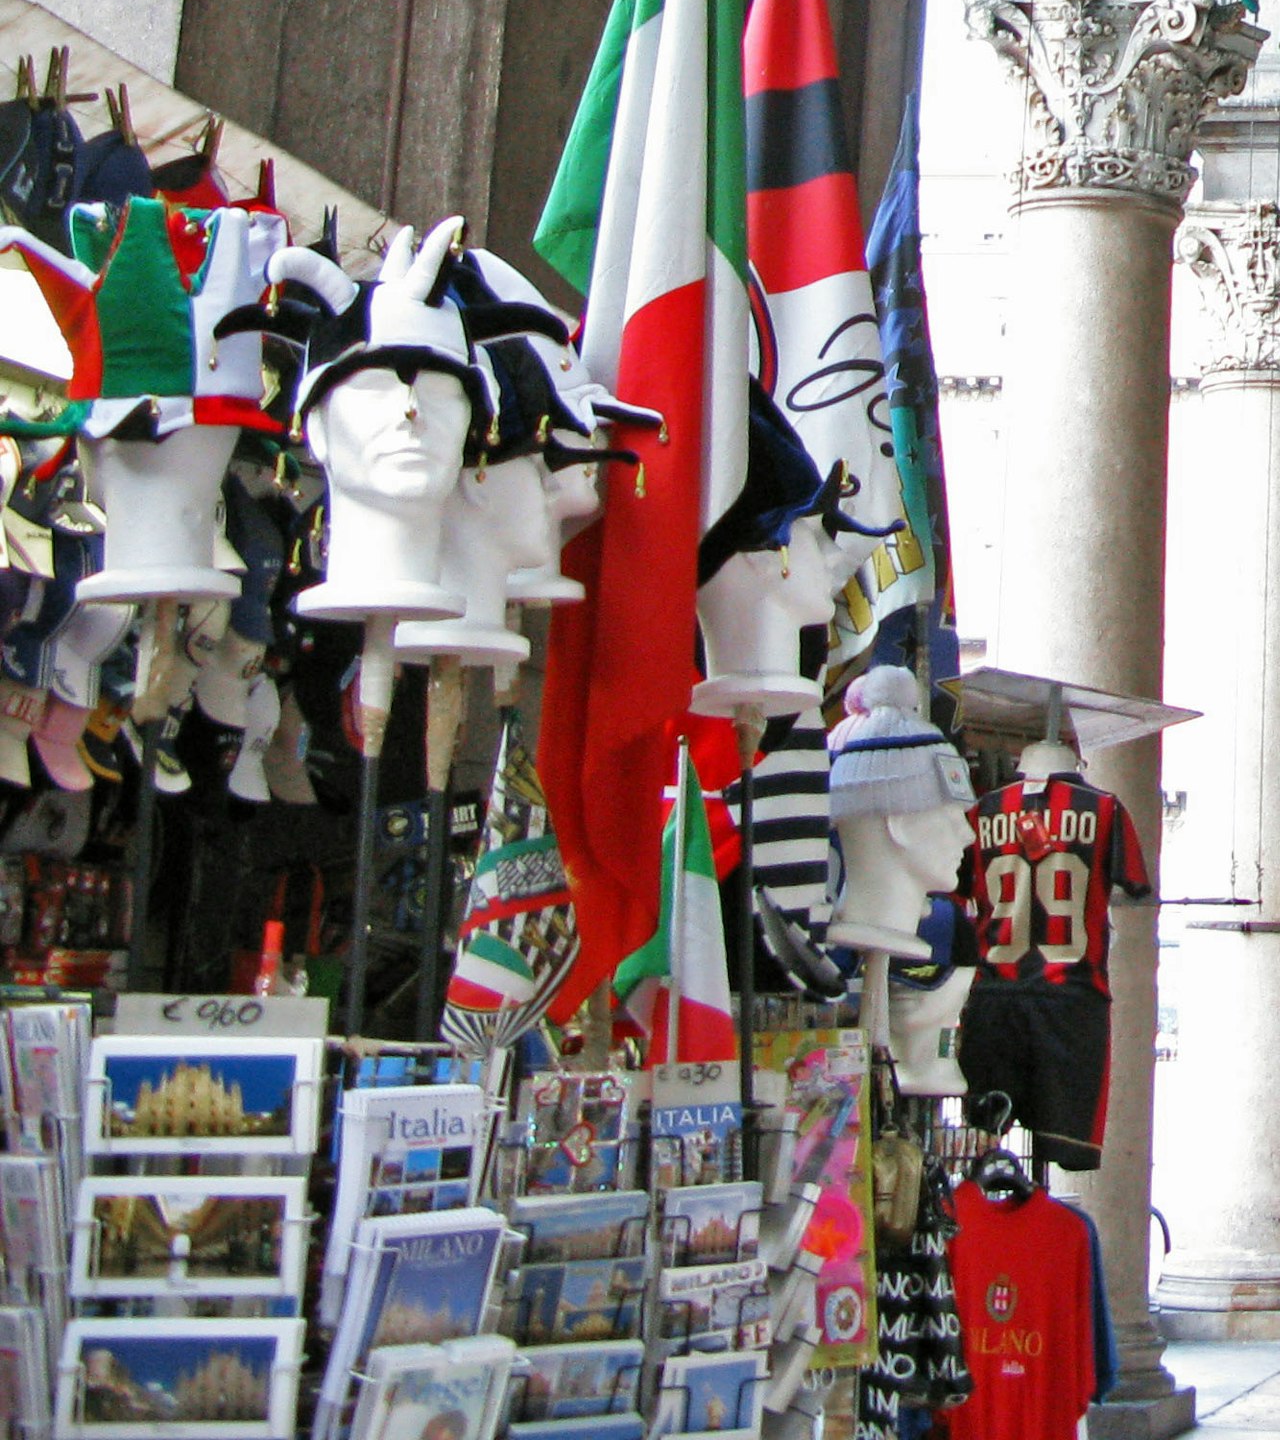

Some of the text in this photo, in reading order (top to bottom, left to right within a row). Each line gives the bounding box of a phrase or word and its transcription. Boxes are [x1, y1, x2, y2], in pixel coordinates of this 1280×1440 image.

[978, 809, 1097, 850] RONLDO
[985, 852, 1090, 964] 99
[387, 1109, 466, 1139] Italia
[655, 1105, 736, 1128] ITALIA
[400, 1233, 485, 1262] MILANO
